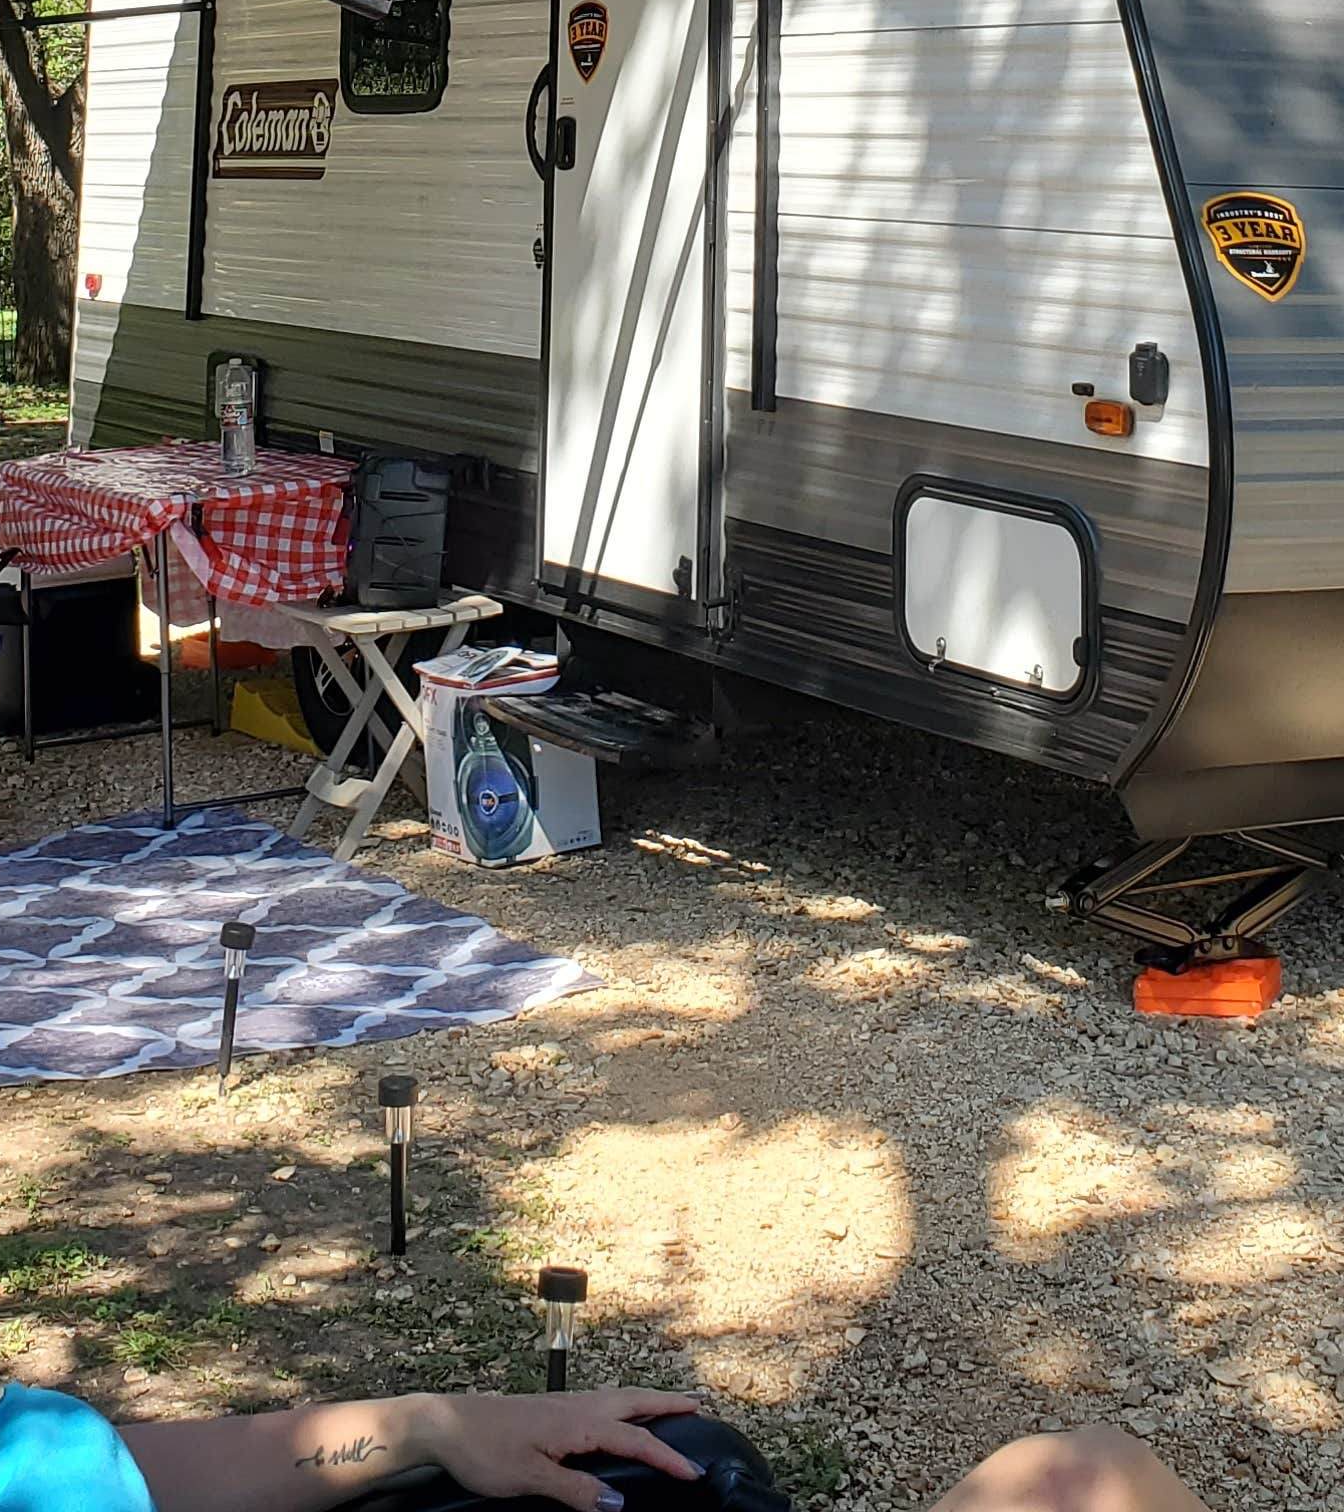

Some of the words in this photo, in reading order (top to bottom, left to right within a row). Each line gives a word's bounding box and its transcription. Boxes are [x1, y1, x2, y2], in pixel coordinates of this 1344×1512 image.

[571, 27, 577, 41] 3
[579, 21, 604, 38] YEAR
[222, 90, 310, 156] Coleman
[1216, 225, 1232, 241] 3
[1232, 221, 1296, 243] YEAR
